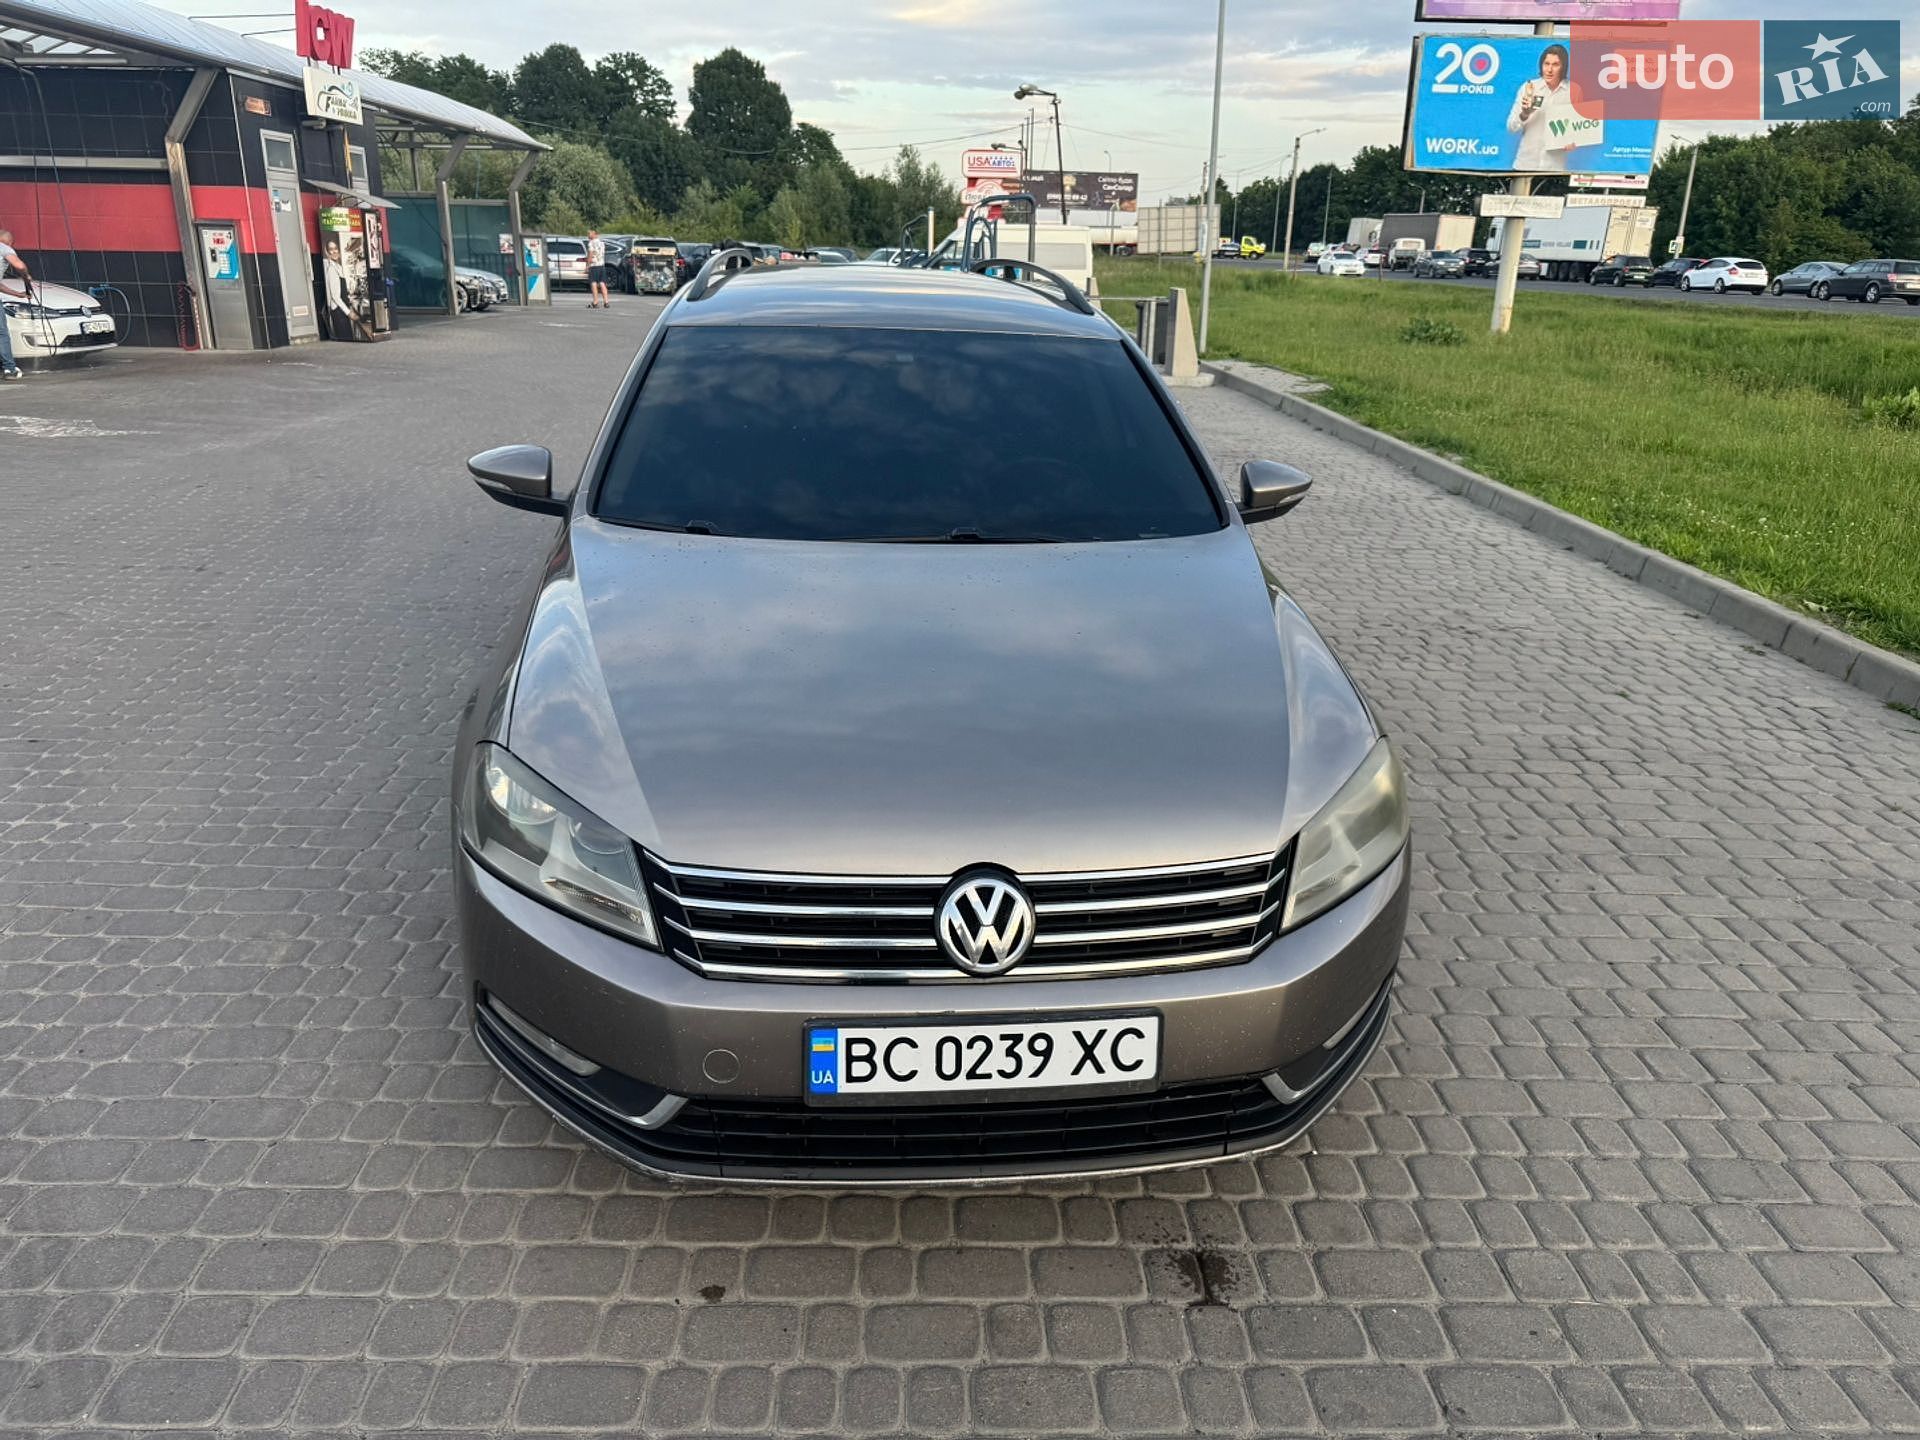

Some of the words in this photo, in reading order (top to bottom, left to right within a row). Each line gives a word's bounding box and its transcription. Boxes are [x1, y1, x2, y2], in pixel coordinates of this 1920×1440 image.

[1435, 42, 1499, 84] 20
[1460, 84, 1494, 94] РОКІВ
[1425, 136, 1499, 155] WORK.ua
[968, 156, 991, 166] USA
[845, 1036, 919, 1083] BC
[934, 1031, 1055, 1081] 0239
[1070, 1027, 1146, 1076] XC
[811, 1070, 834, 1085] UA
